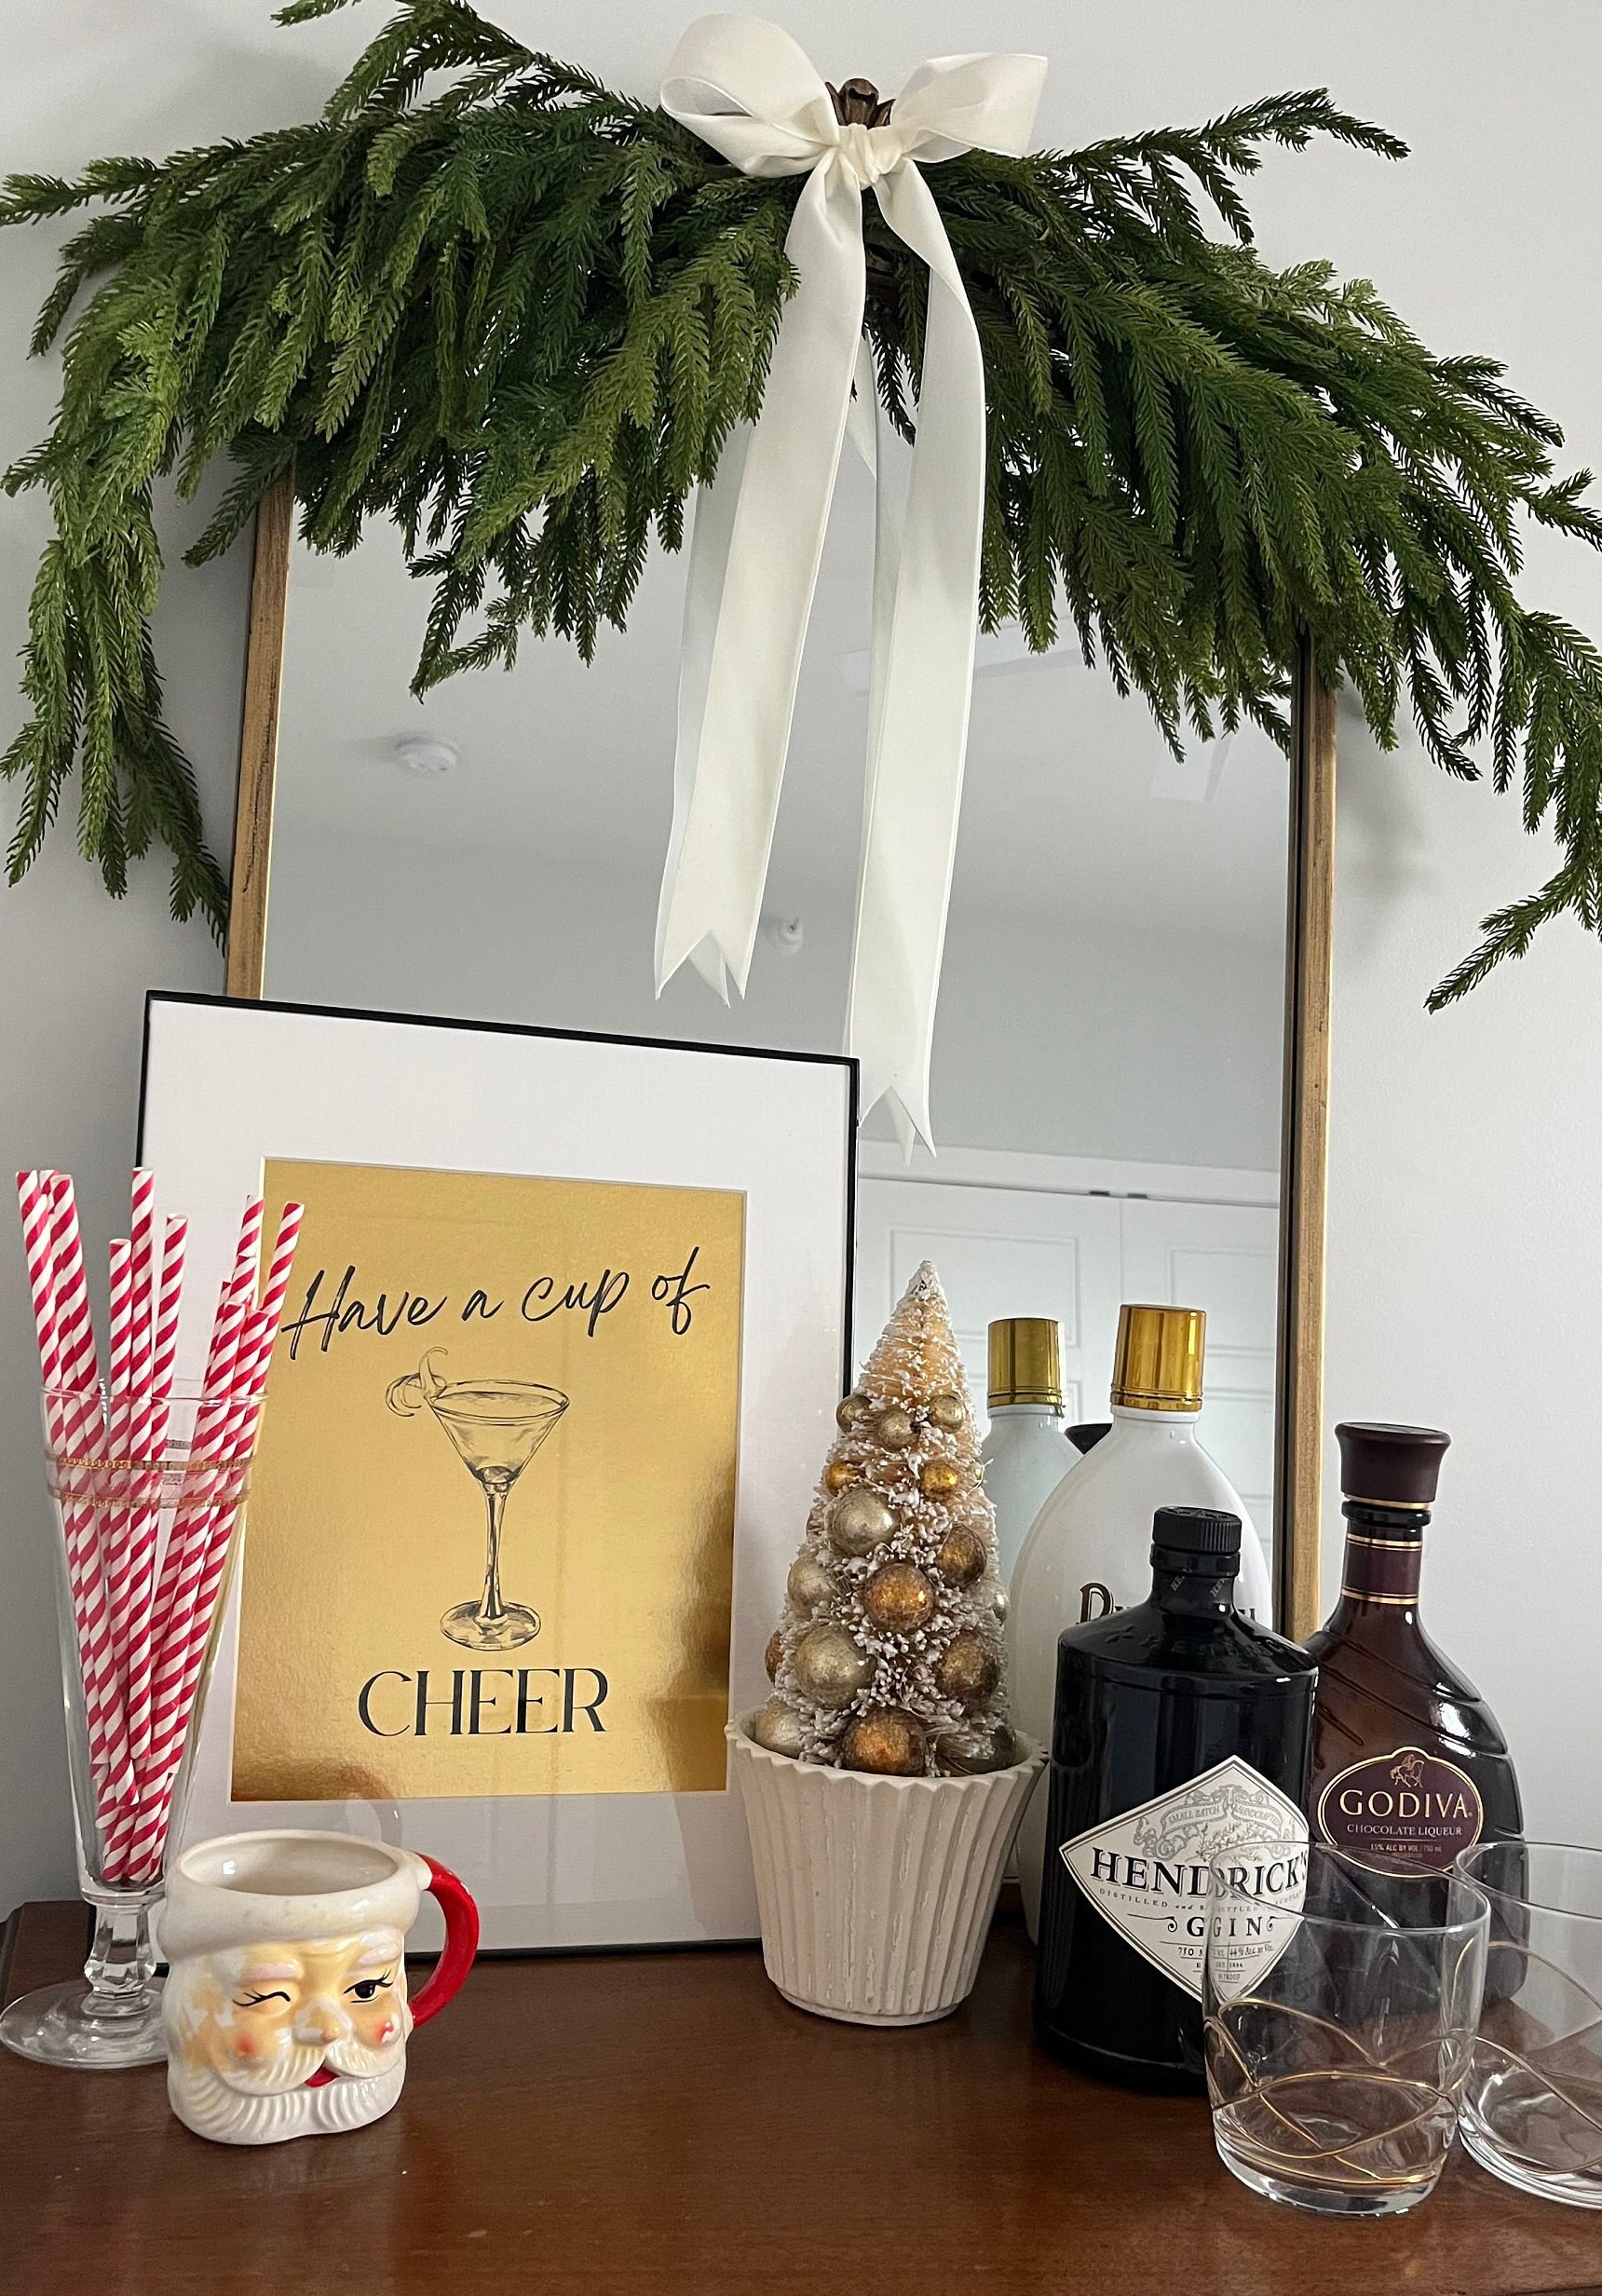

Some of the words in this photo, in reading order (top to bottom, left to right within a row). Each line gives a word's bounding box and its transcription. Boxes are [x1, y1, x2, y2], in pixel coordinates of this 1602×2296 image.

[280, 1265, 448, 1360] Have
[461, 1289, 504, 1322] a
[521, 1269, 631, 1338] cup
[651, 1246, 711, 1336] of
[358, 1667, 609, 1738] CHEER
[1339, 1789, 1468, 1818] GODIVA
[1347, 1824, 1416, 1836] CHOCOLATE
[1418, 1826, 1462, 1838] LIQUEUR
[1099, 1887, 1169, 1909] DISTILLED
